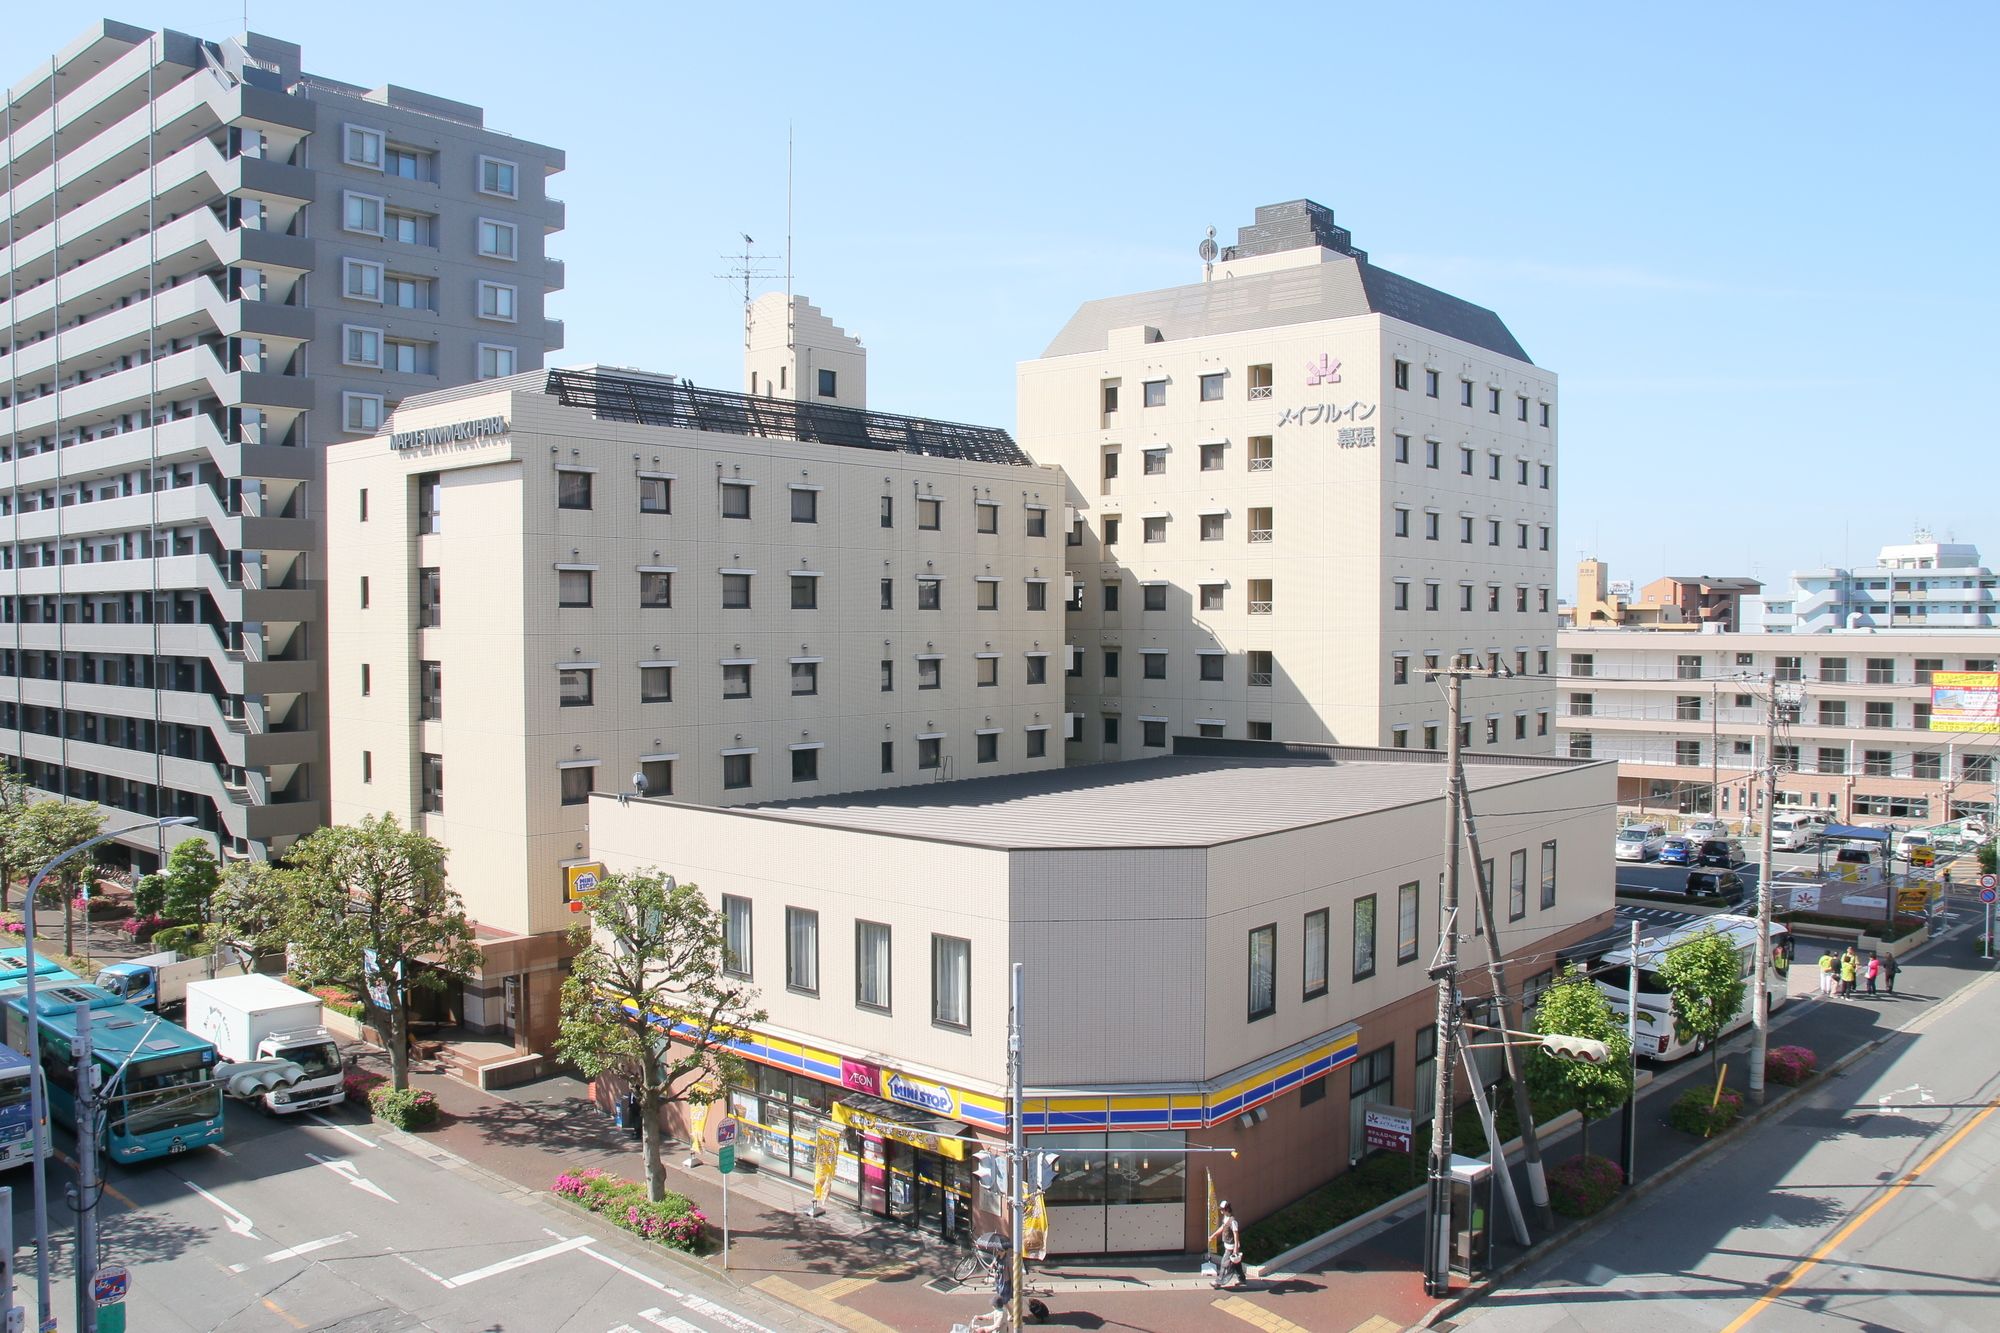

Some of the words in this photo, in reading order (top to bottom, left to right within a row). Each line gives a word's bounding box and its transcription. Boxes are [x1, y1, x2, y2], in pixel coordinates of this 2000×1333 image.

[1278, 401, 1376, 428] メイプルイン
[390, 430, 422, 450] MAPLE
[422, 426, 443, 447] INN
[443, 415, 506, 442] MAKUHARI
[1337, 427, 1375, 449] 幕張
[894, 1084, 918, 1101] MINI
[919, 1091, 948, 1108] STOP
